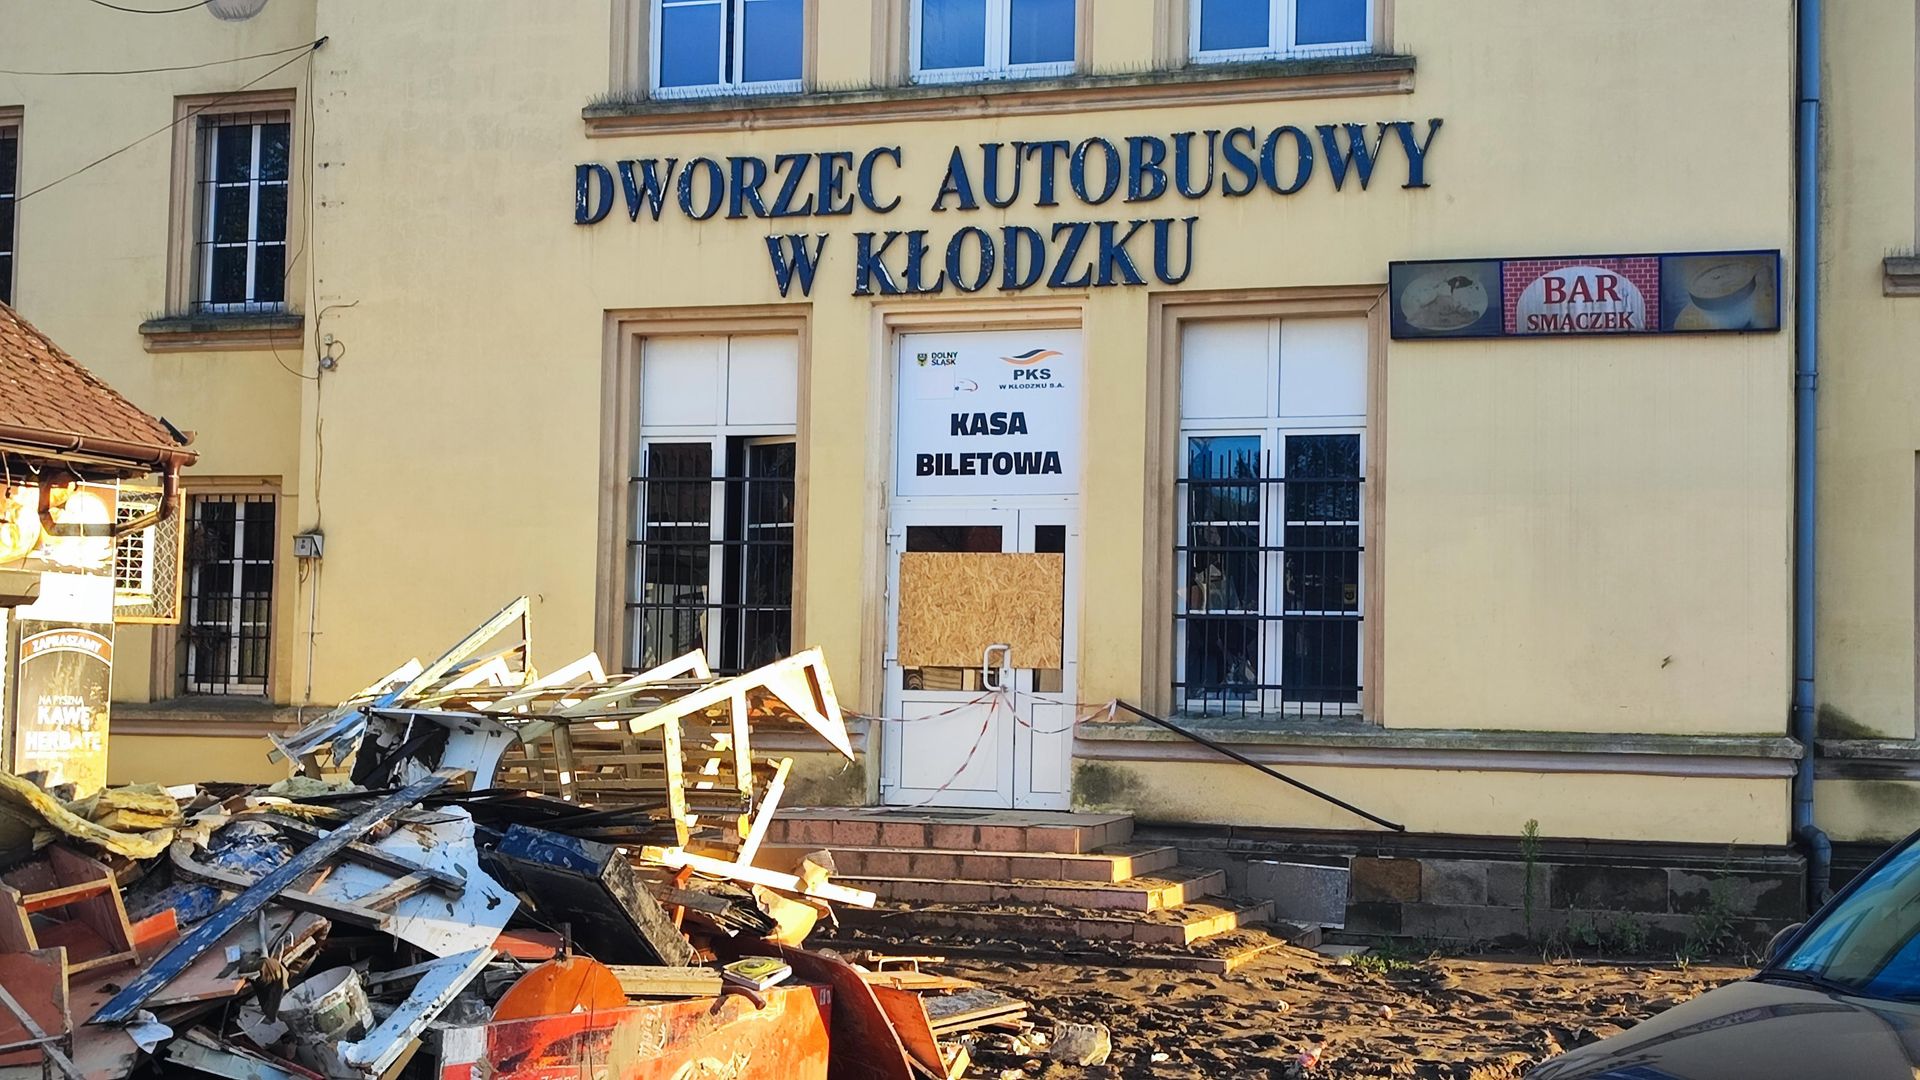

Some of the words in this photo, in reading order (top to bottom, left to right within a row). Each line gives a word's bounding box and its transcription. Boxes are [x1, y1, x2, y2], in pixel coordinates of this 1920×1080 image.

[574, 146, 901, 225] DWORZEC
[931, 118, 1444, 212] AUTOBUSOWY
[764, 232, 830, 298] W
[851, 216, 1200, 297] KŁODZKU
[1543, 274, 1621, 305] BAR
[1527, 311, 1635, 332] SMACZEK
[931, 351, 958, 359] DOLNY
[1013, 368, 1052, 381] PKS
[950, 411, 1028, 437] KASA
[915, 450, 1063, 477] BILETOWA
[32, 634, 102, 654] ZAPRASZAMY
[38, 695, 52, 706] NA
